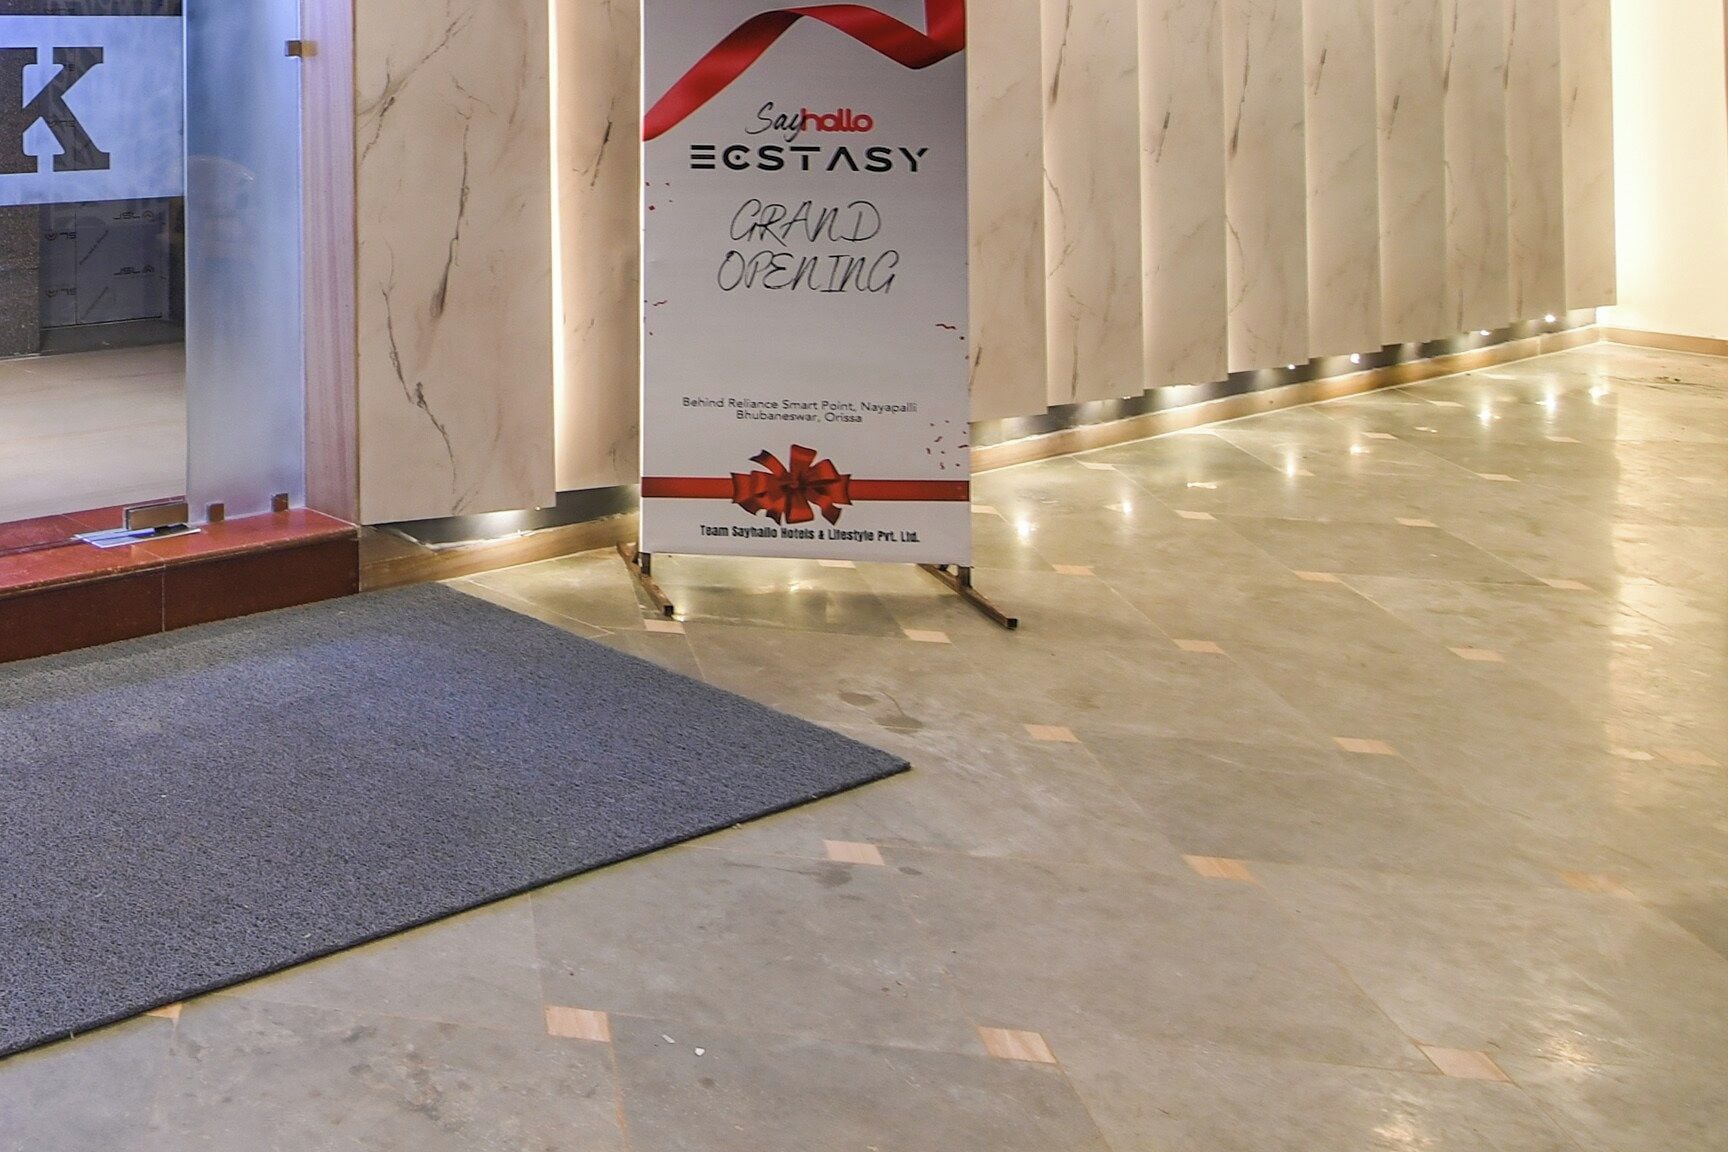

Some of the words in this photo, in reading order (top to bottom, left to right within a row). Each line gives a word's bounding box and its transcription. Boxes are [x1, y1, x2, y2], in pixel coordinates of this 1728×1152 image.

[745, 102, 874, 142] Sayhallo
[690, 144, 929, 172] ECSTASY
[730, 198, 882, 247] GRAND
[717, 250, 899, 294] OPENING
[682, 397, 724, 408] Behind
[728, 398, 778, 409] Reliance
[782, 399, 818, 410] Smart
[821, 400, 857, 412] Point,
[861, 402, 917, 414] Nayapalli
[736, 410, 821, 422] Bhubaneswar,
[825, 412, 862, 422] Orissa
[700, 525, 729, 536] Team
[732, 526, 777, 539] Sayhallo
[781, 528, 814, 539] Hotels
[818, 530, 824, 540] &
[828, 529, 874, 542] Lifestyle
[877, 530, 898, 542] Pvt.
[900, 530, 920, 542] Ltd.
